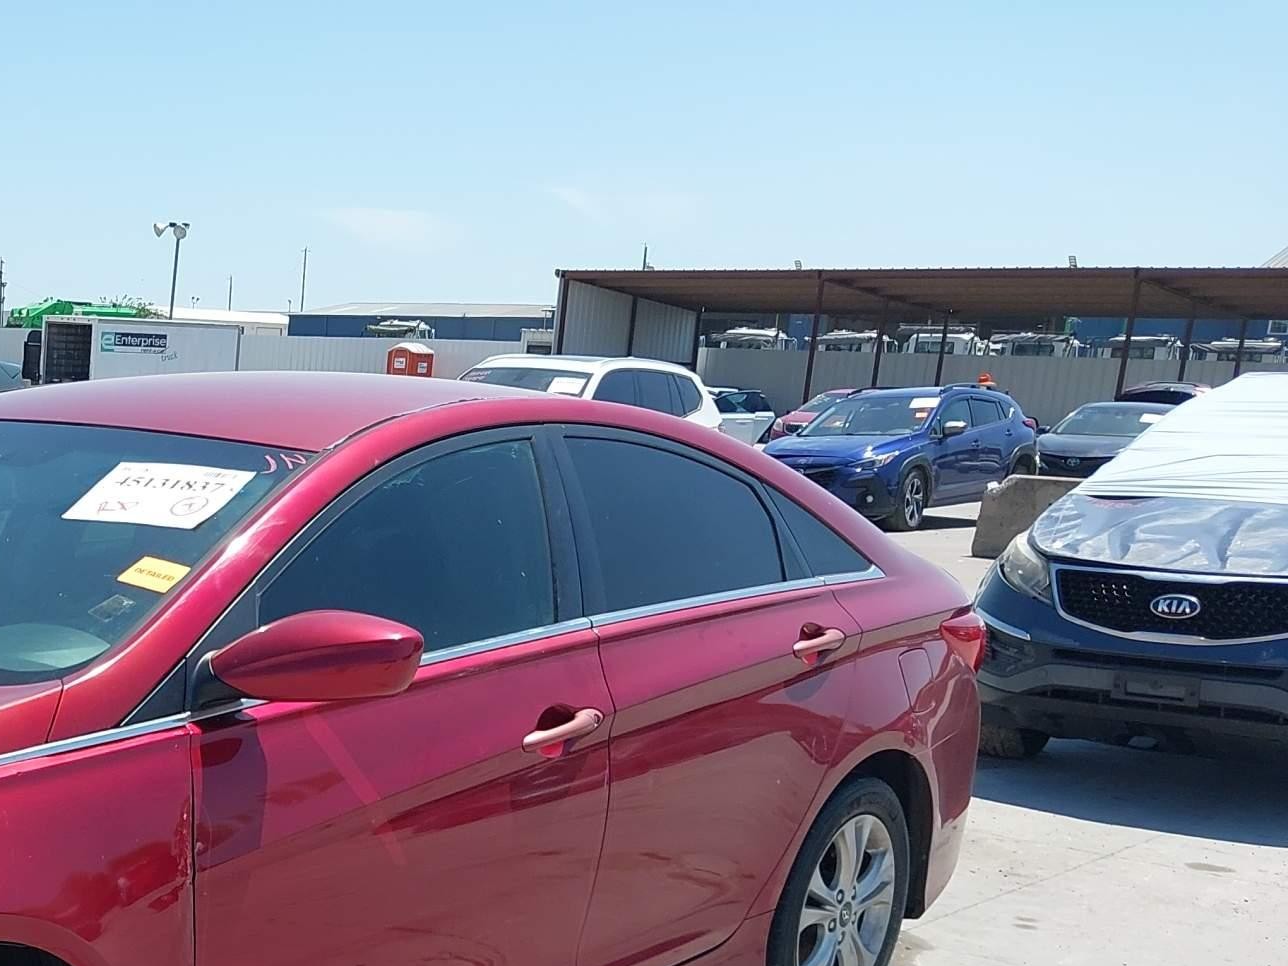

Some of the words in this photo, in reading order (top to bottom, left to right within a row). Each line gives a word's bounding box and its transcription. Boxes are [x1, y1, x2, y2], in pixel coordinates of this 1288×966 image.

[115, 335, 167, 347] Enterprise
[115, 475, 228, 494] 45131837
[1157, 599, 1191, 614] KIA
